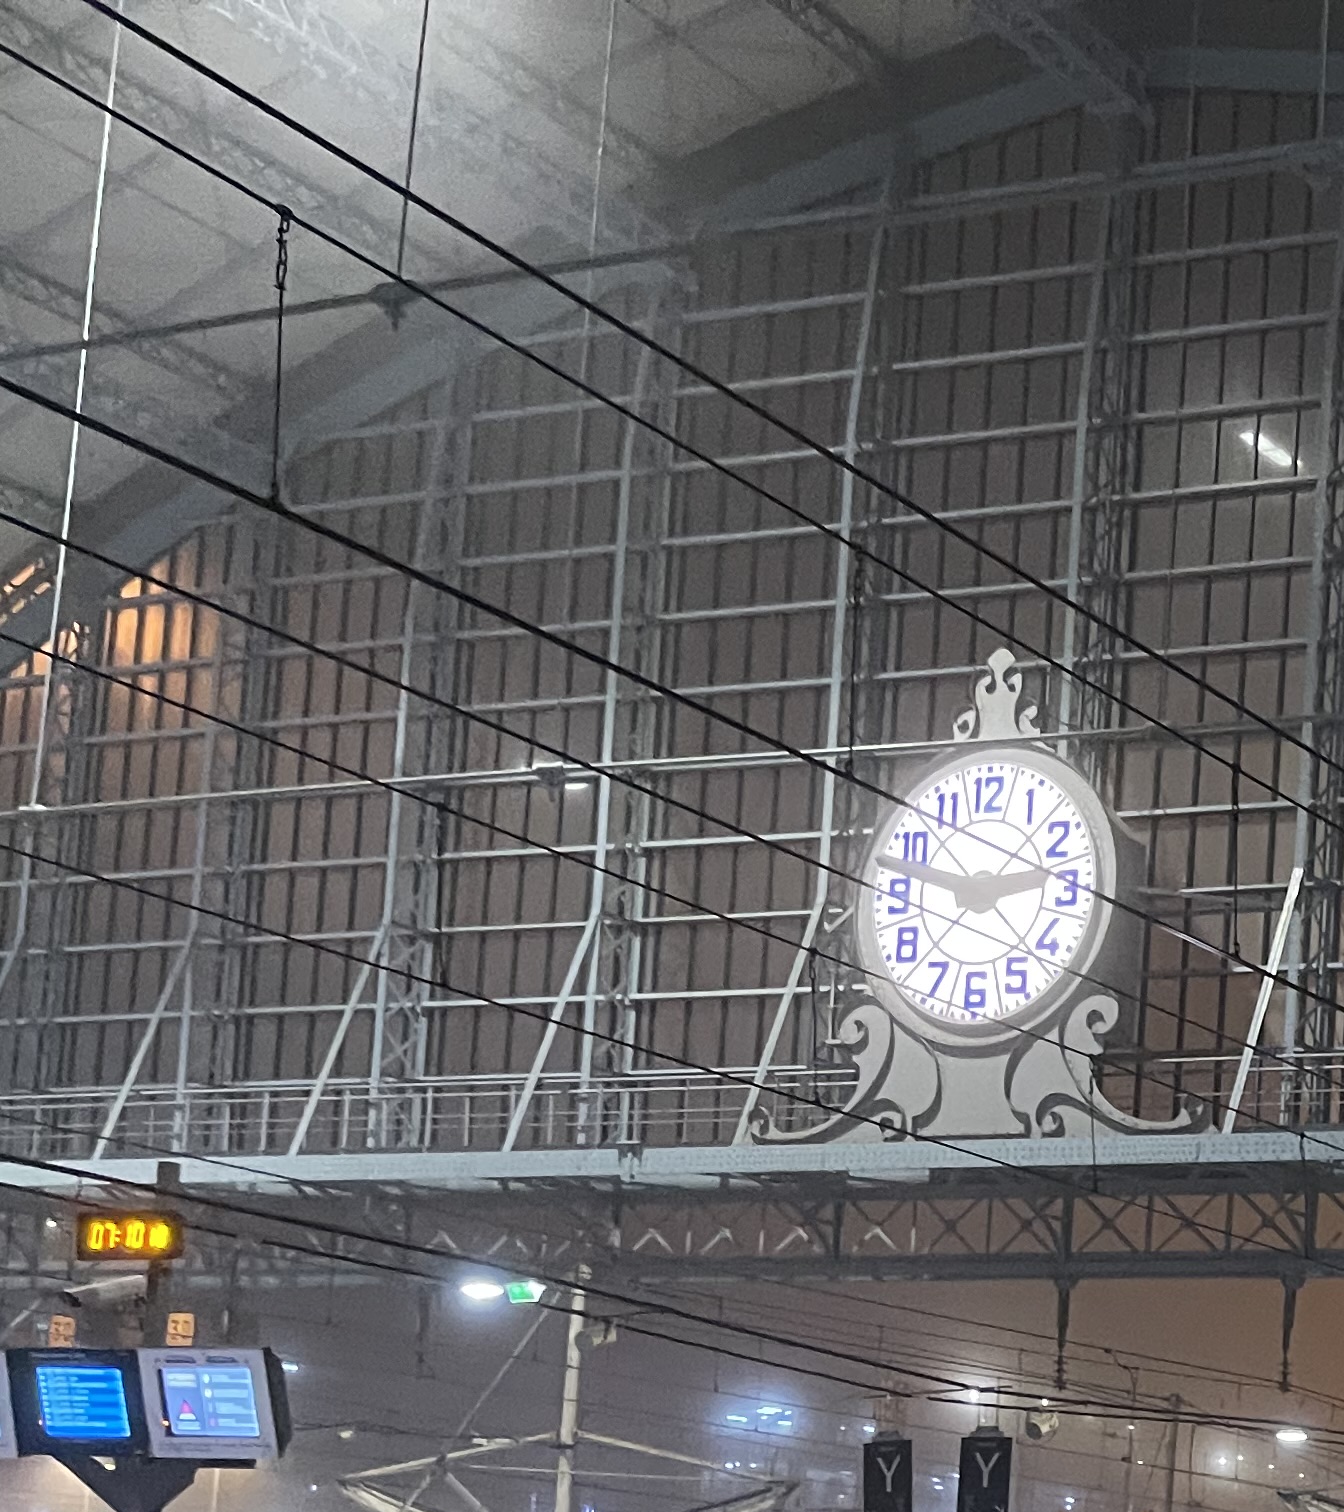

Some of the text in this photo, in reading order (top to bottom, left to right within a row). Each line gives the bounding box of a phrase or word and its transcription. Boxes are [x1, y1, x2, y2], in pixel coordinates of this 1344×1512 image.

[937, 792, 959, 829] 11
[974, 776, 1004, 813] 12
[1026, 788, 1034, 825] 1
[903, 831, 928, 866] 10
[1046, 821, 1070, 858] 2
[888, 878, 910, 914] 9
[1055, 869, 1078, 907] 3
[895, 926, 919, 963] 8
[1034, 917, 1060, 956] 4
[927, 961, 950, 997] 7
[964, 971, 987, 1009] 6
[1004, 956, 1028, 994] 5
[87, 1220, 145, 1250] 07:10
[876, 1454, 900, 1492] Y
[975, 1452, 1000, 1488] Y
